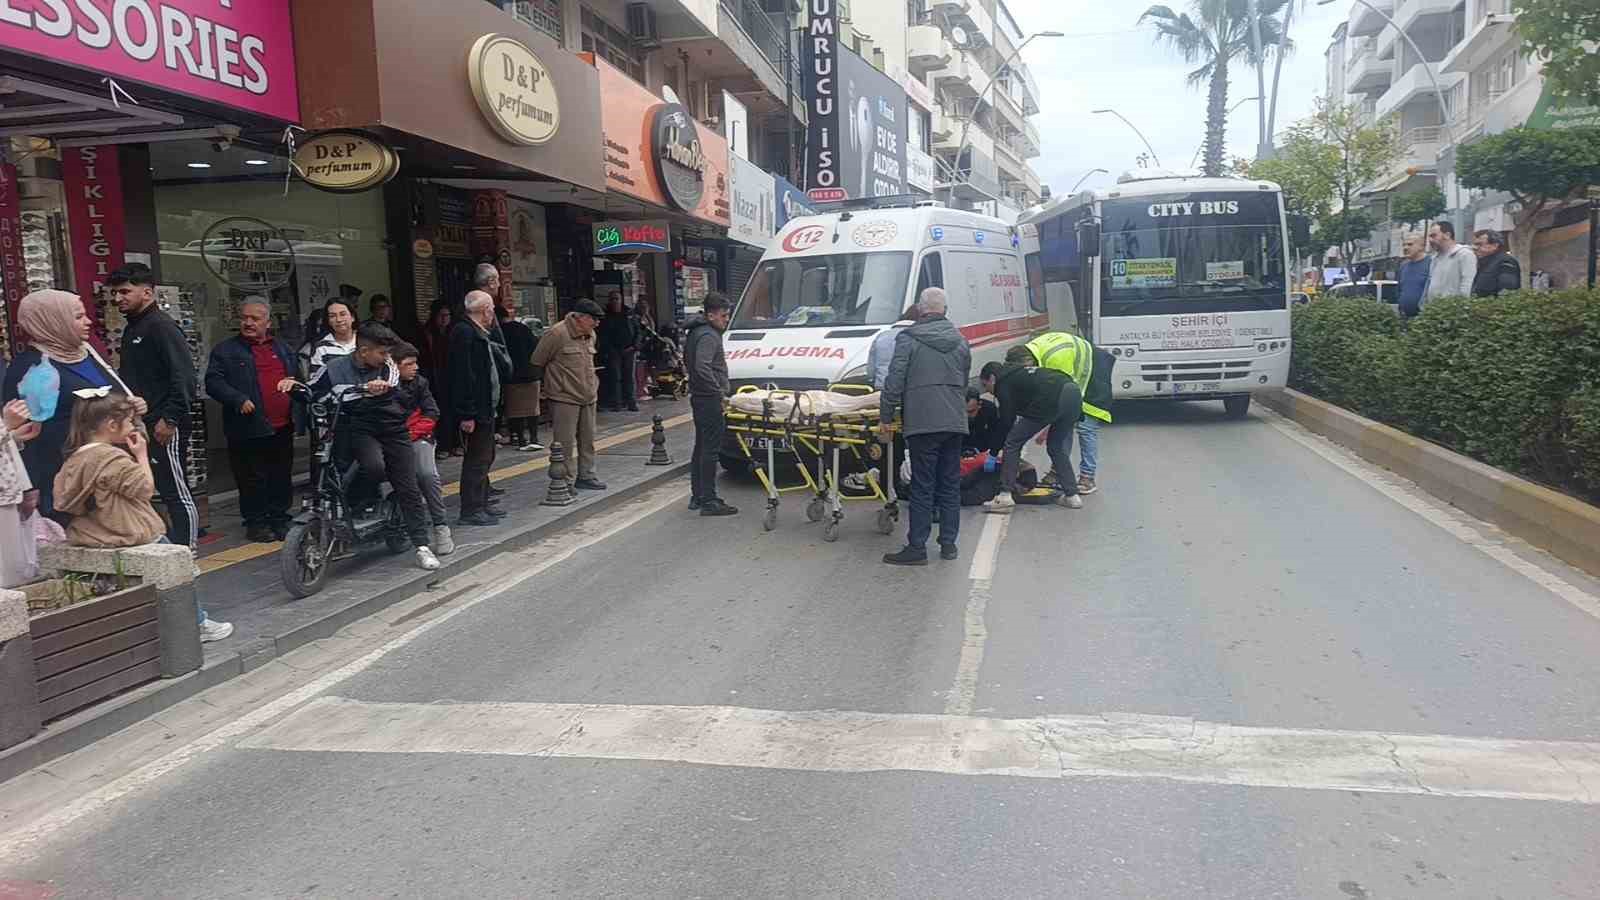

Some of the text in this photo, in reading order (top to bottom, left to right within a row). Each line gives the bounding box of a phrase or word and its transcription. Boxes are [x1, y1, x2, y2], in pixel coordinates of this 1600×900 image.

[498, 91, 553, 126] perfumum
[306, 159, 373, 177] perfumum
[1147, 200, 1240, 218] CITY BUS
[794, 230, 824, 247] 112
[1113, 262, 1126, 275] 10
[1171, 316, 1210, 328] ŞEHİR
